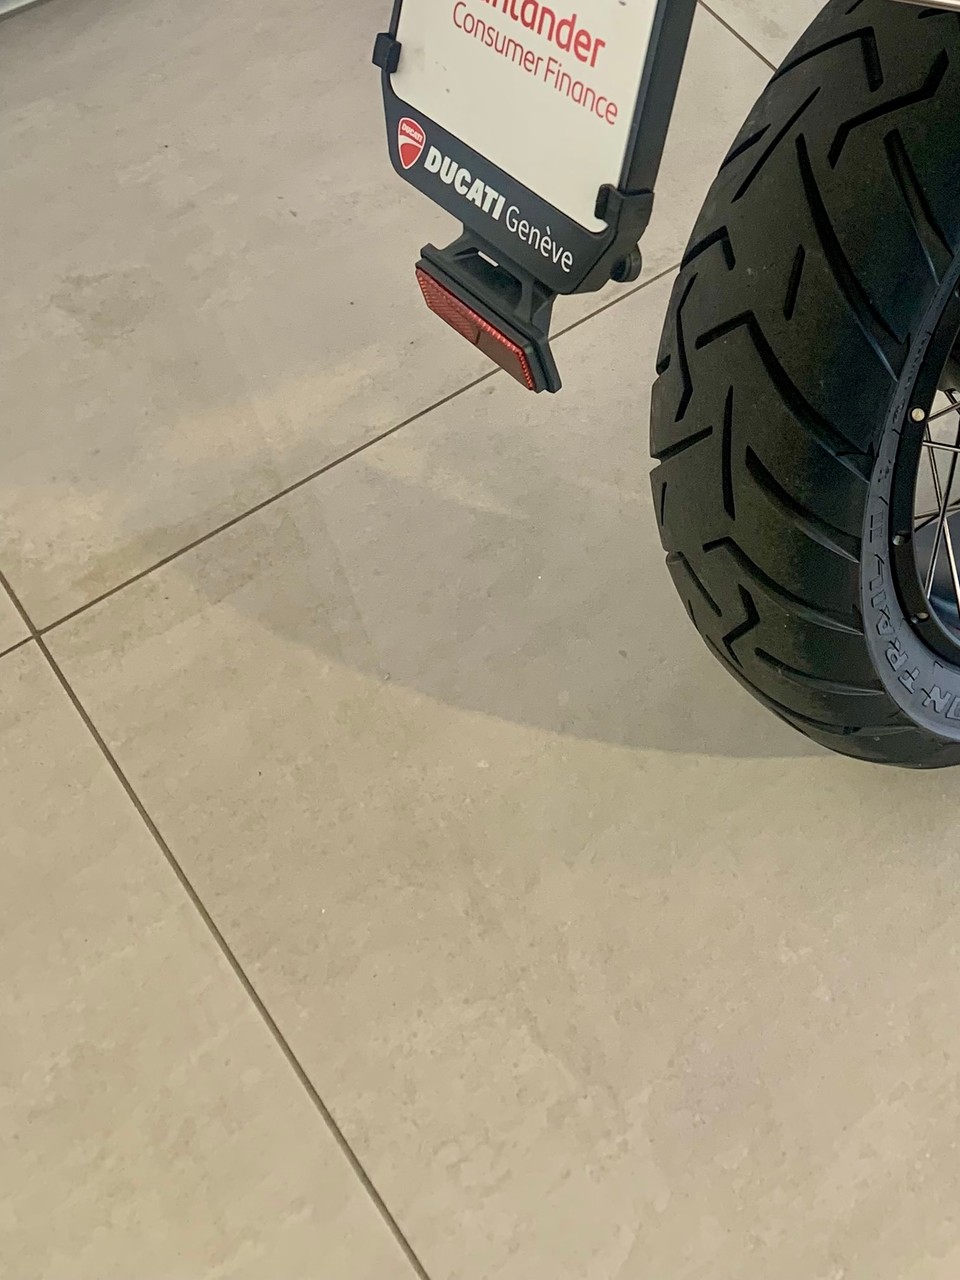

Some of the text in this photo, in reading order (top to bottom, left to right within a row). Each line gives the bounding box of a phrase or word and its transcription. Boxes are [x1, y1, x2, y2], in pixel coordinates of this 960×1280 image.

[453, 1, 618, 125] Consumer Finance
[401, 123, 423, 143] DUCATI
[423, 145, 573, 272] DUCATI Genève
[869, 554, 921, 695] TRAIL
